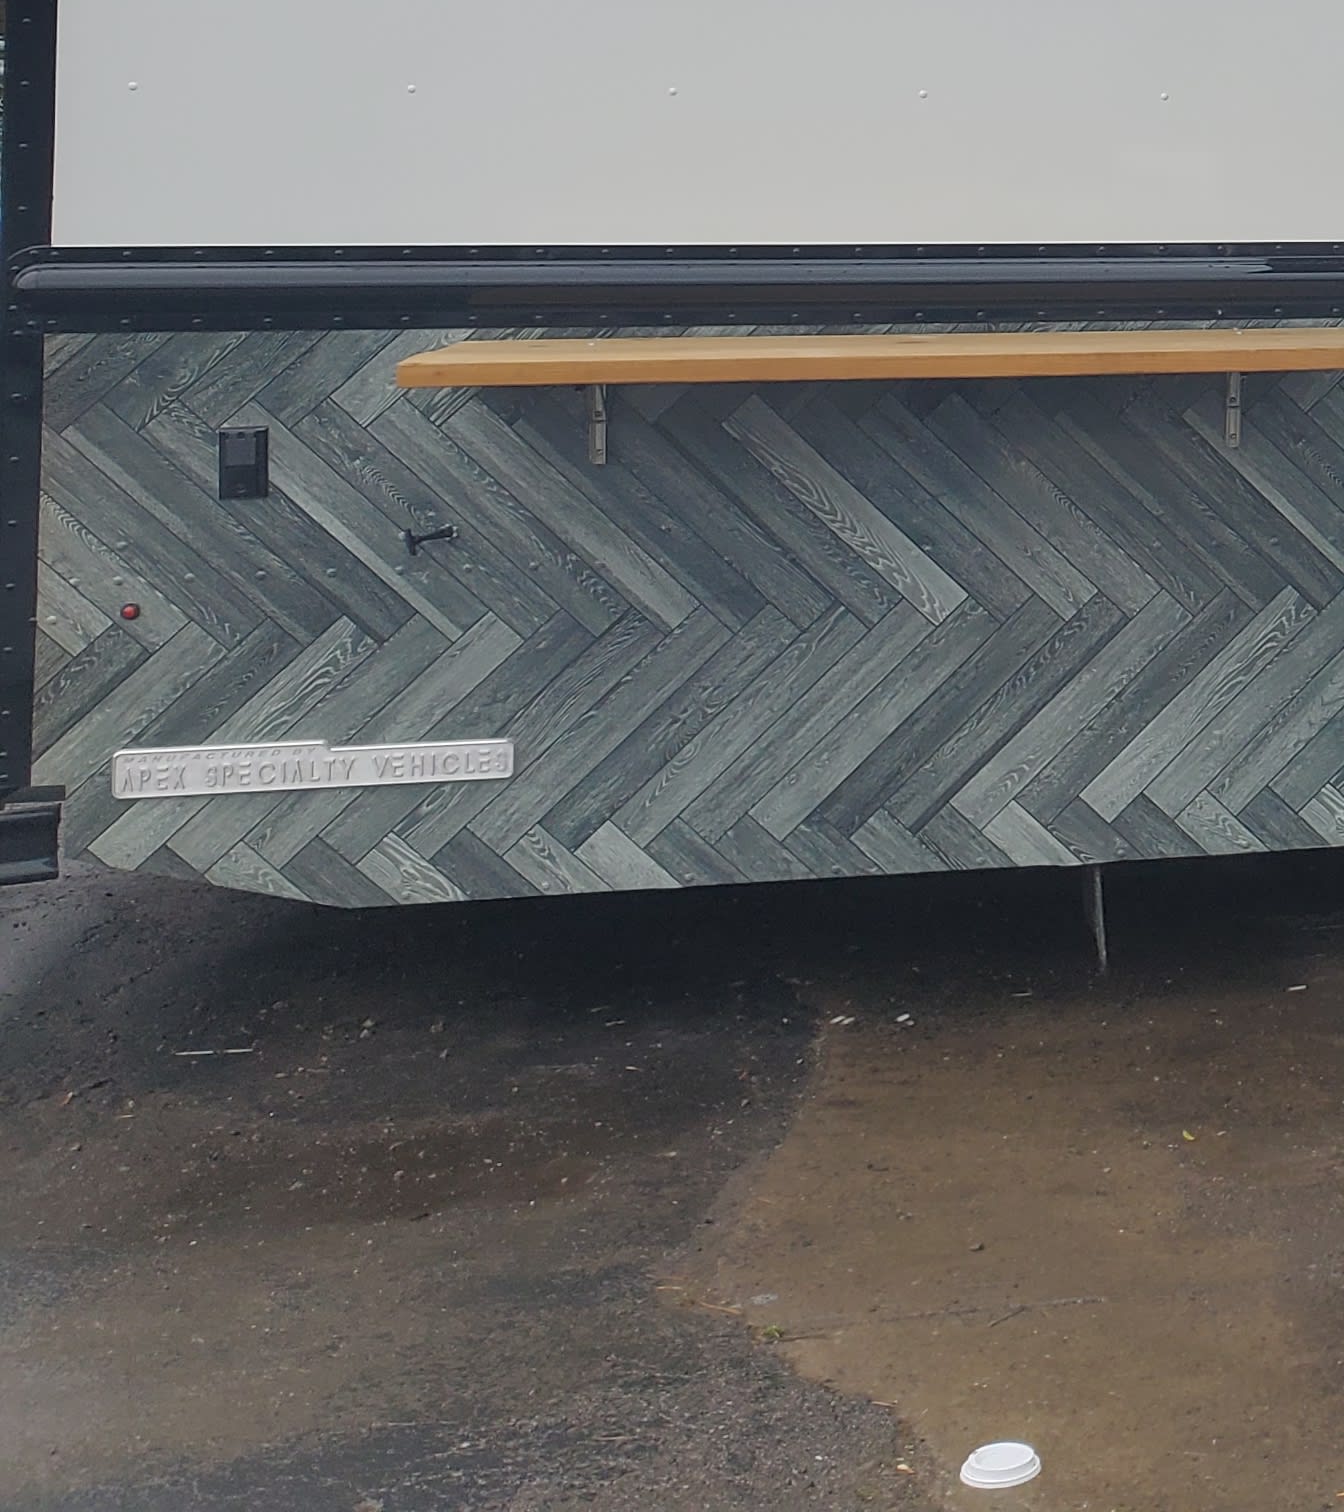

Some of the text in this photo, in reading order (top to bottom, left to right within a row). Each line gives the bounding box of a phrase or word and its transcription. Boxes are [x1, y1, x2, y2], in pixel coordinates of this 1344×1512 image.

[120, 748, 510, 794] APEX SPECIALTY VEHICLES
[122, 748, 281, 764] MANUFACTURED
